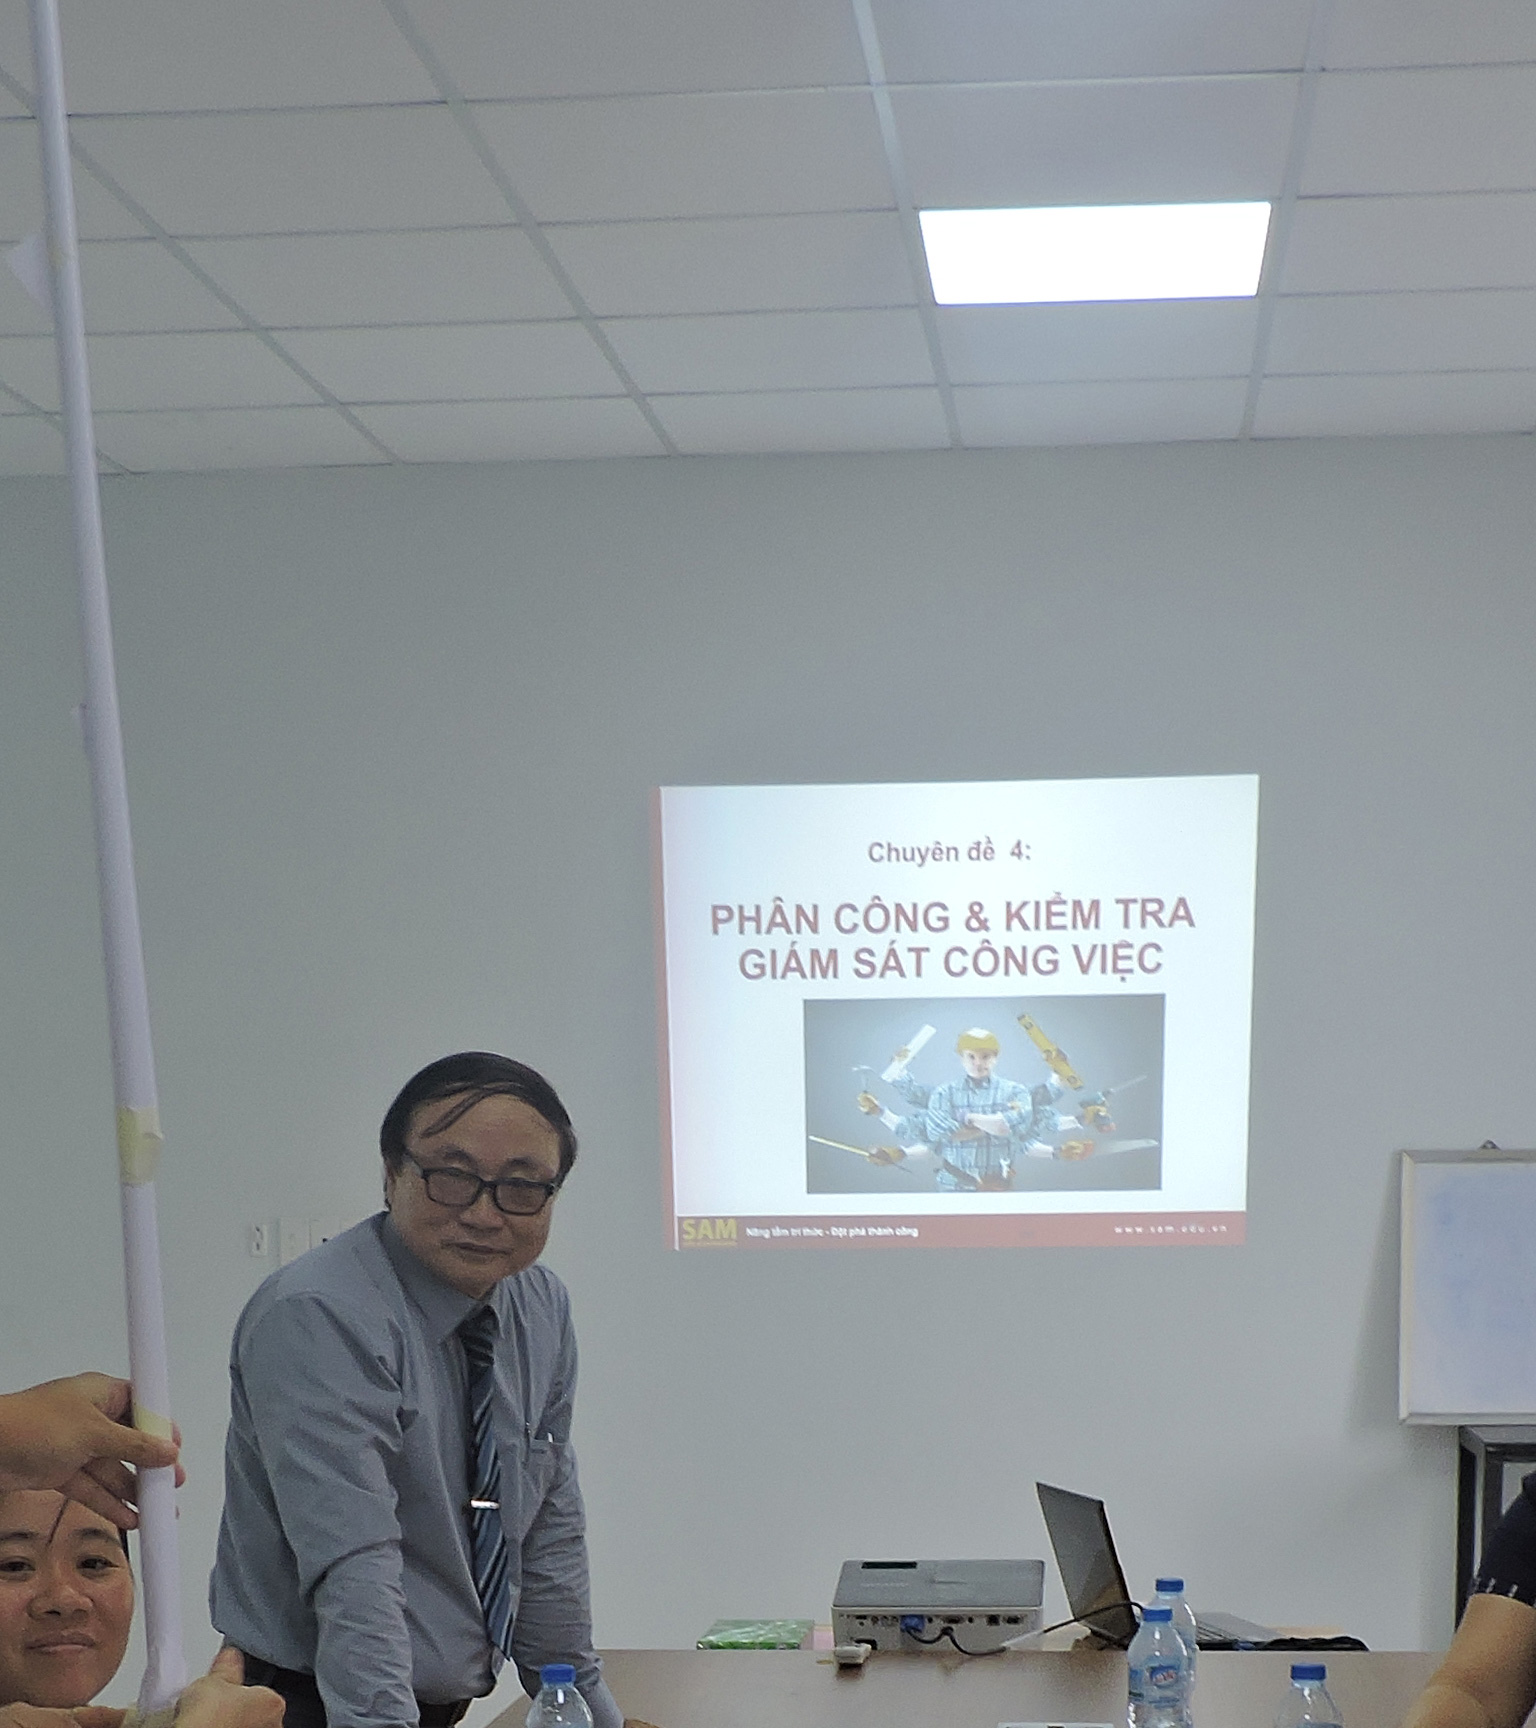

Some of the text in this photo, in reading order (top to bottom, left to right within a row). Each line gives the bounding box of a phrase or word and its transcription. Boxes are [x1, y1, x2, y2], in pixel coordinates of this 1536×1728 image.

[868, 836, 1032, 866] Chuyên đề 4:
[711, 890, 1196, 935] PHÂN CÔNG & KIỂM TRA
[739, 939, 1164, 982] GIÁM SÁT CÔNG VIỆC
[682, 1218, 737, 1240] SAM
